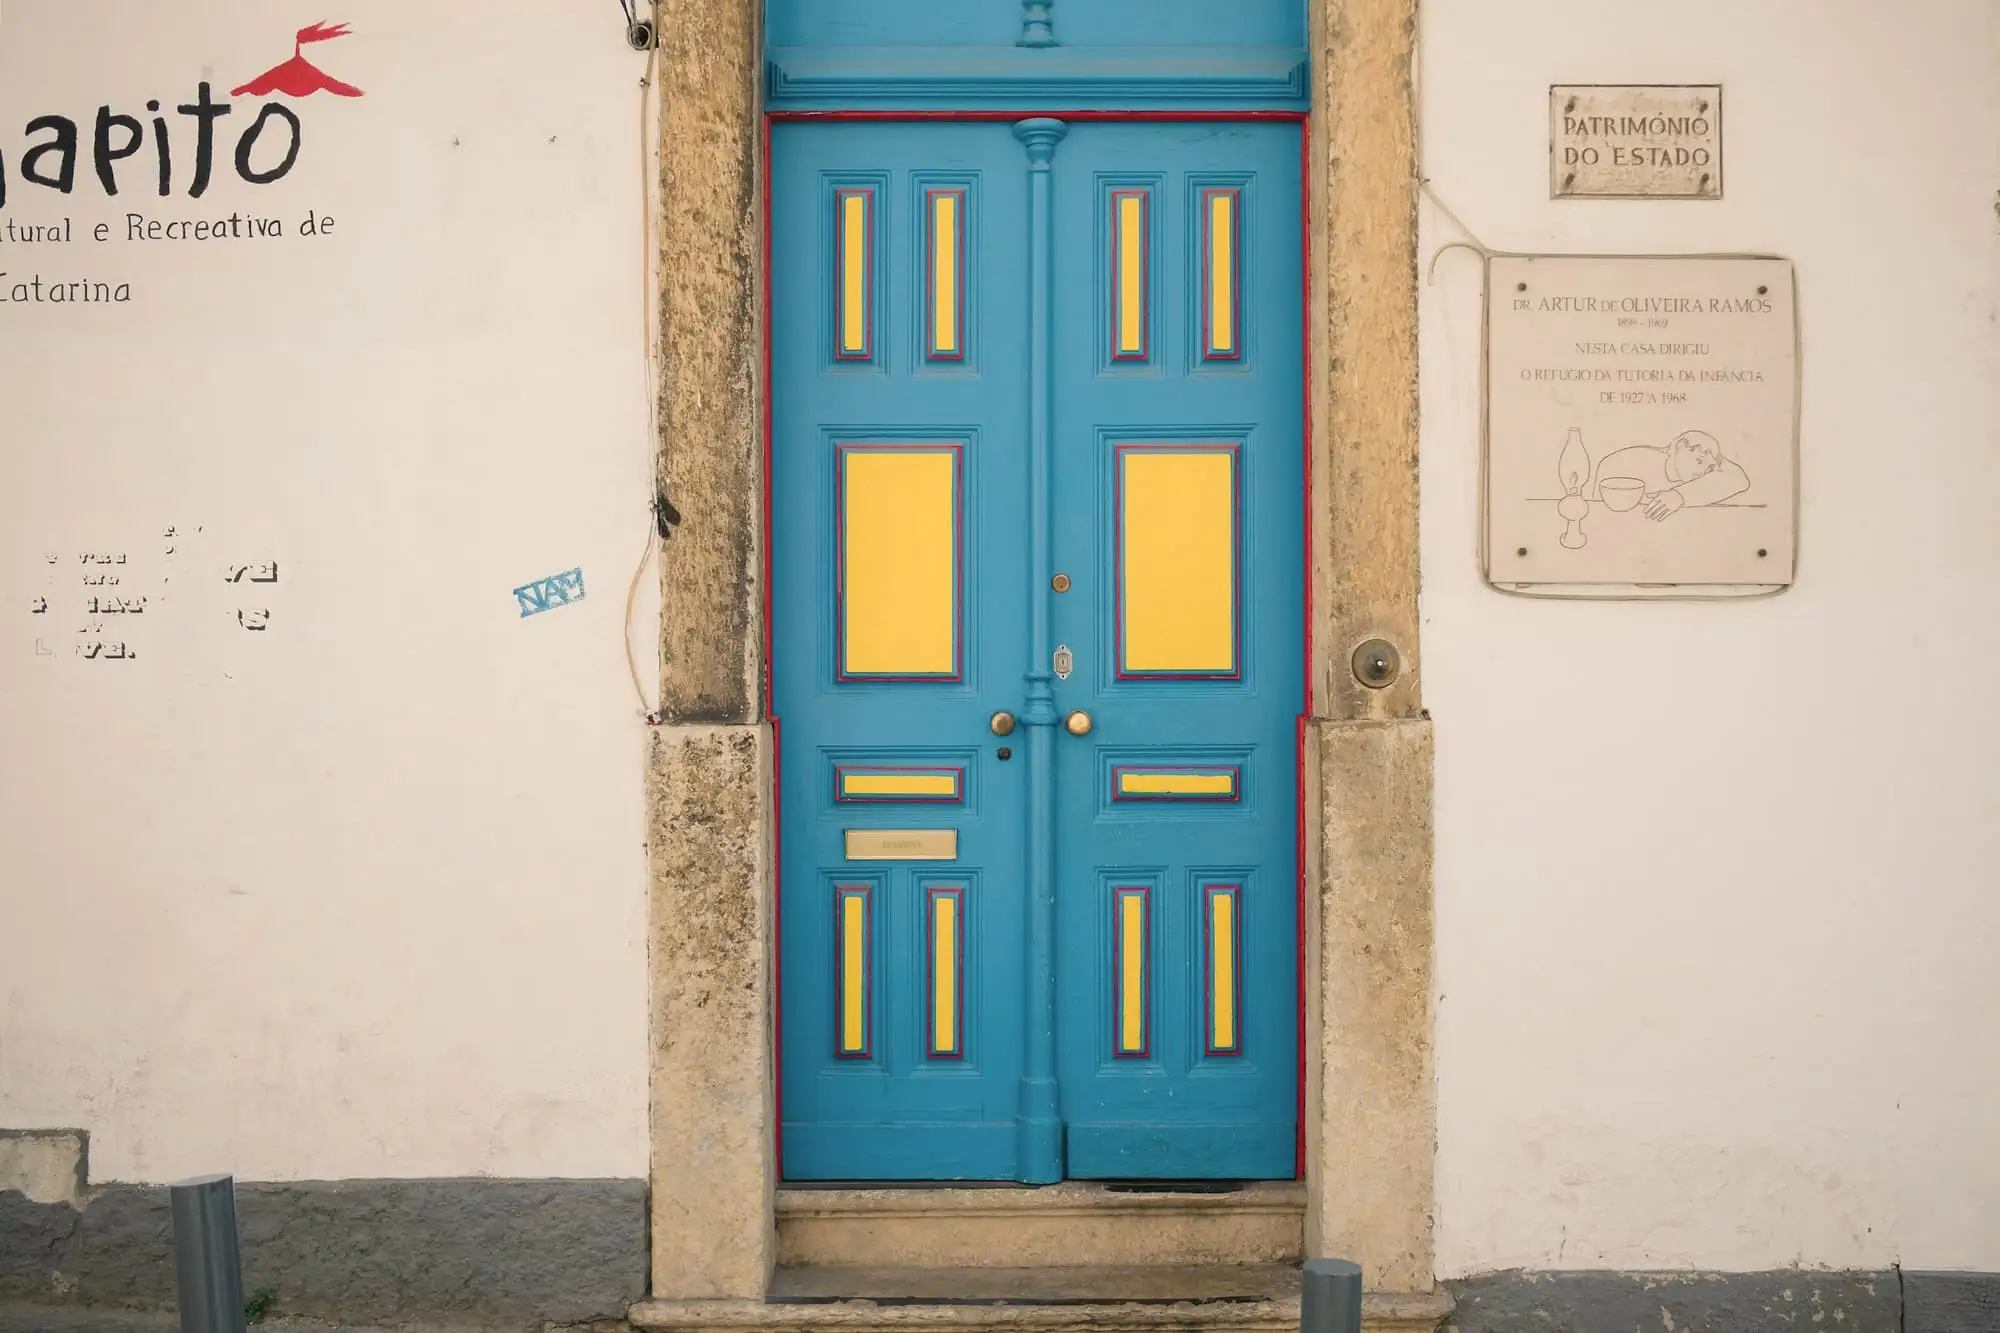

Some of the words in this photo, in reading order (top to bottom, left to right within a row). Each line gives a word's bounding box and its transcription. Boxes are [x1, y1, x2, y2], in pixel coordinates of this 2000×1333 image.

[1563, 112, 1709, 137] PATRIMÓNIO
[0, 81, 301, 208] apito
[1565, 147, 1599, 166] DO
[1613, 147, 1710, 167] ESTADO
[0, 217, 71, 243] tural
[94, 222, 109, 242] e
[126, 212, 283, 242] Recreativa
[300, 210, 335, 236] de
[1513, 299, 1533, 311] DR.
[1539, 296, 1597, 312] ARTUR
[1621, 297, 1704, 313] OLIVEIRA
[1709, 297, 1772, 314] RAMOS
[1575, 342, 1617, 355] NESTA
[1620, 342, 1656, 355] CASA
[1659, 343, 1710, 355] DIRIGIU
[1520, 368, 1531, 381] O
[1594, 368, 1612, 381] DA
[1616, 368, 1675, 382] TUTORIA
[1678, 369, 1696, 382] DA
[1600, 391, 1617, 404] DE
[1620, 391, 1645, 404] 1927
[1660, 391, 1688, 405] 1968
